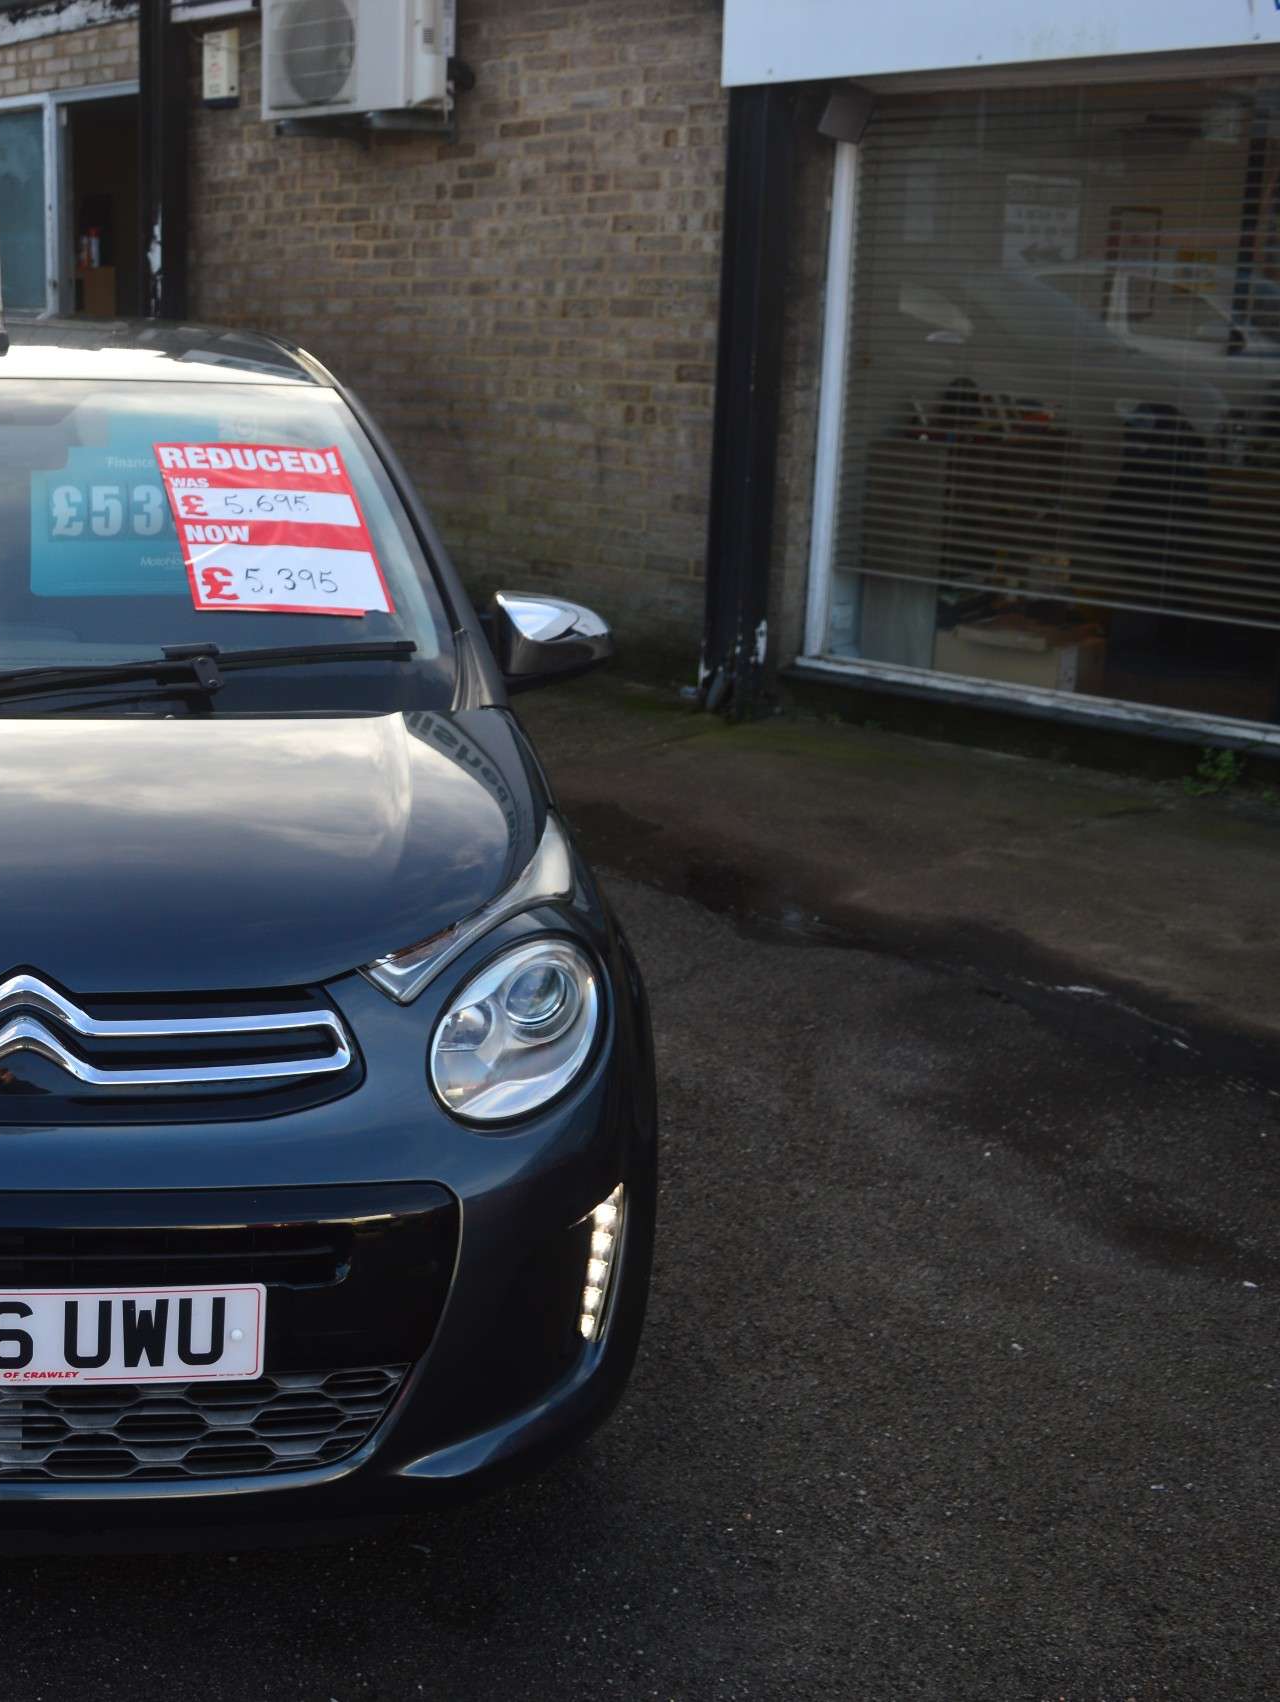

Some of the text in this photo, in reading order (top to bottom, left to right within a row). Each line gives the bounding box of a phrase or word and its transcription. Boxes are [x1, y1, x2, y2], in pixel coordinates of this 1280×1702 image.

[158, 446, 341, 476] REDUCED!
[170, 477, 209, 488] WAS
[52, 485, 167, 537] £53
[181, 495, 208, 516] £
[184, 524, 249, 542] NOW
[201, 566, 240, 600] £
[64, 1297, 226, 1368] UWU
